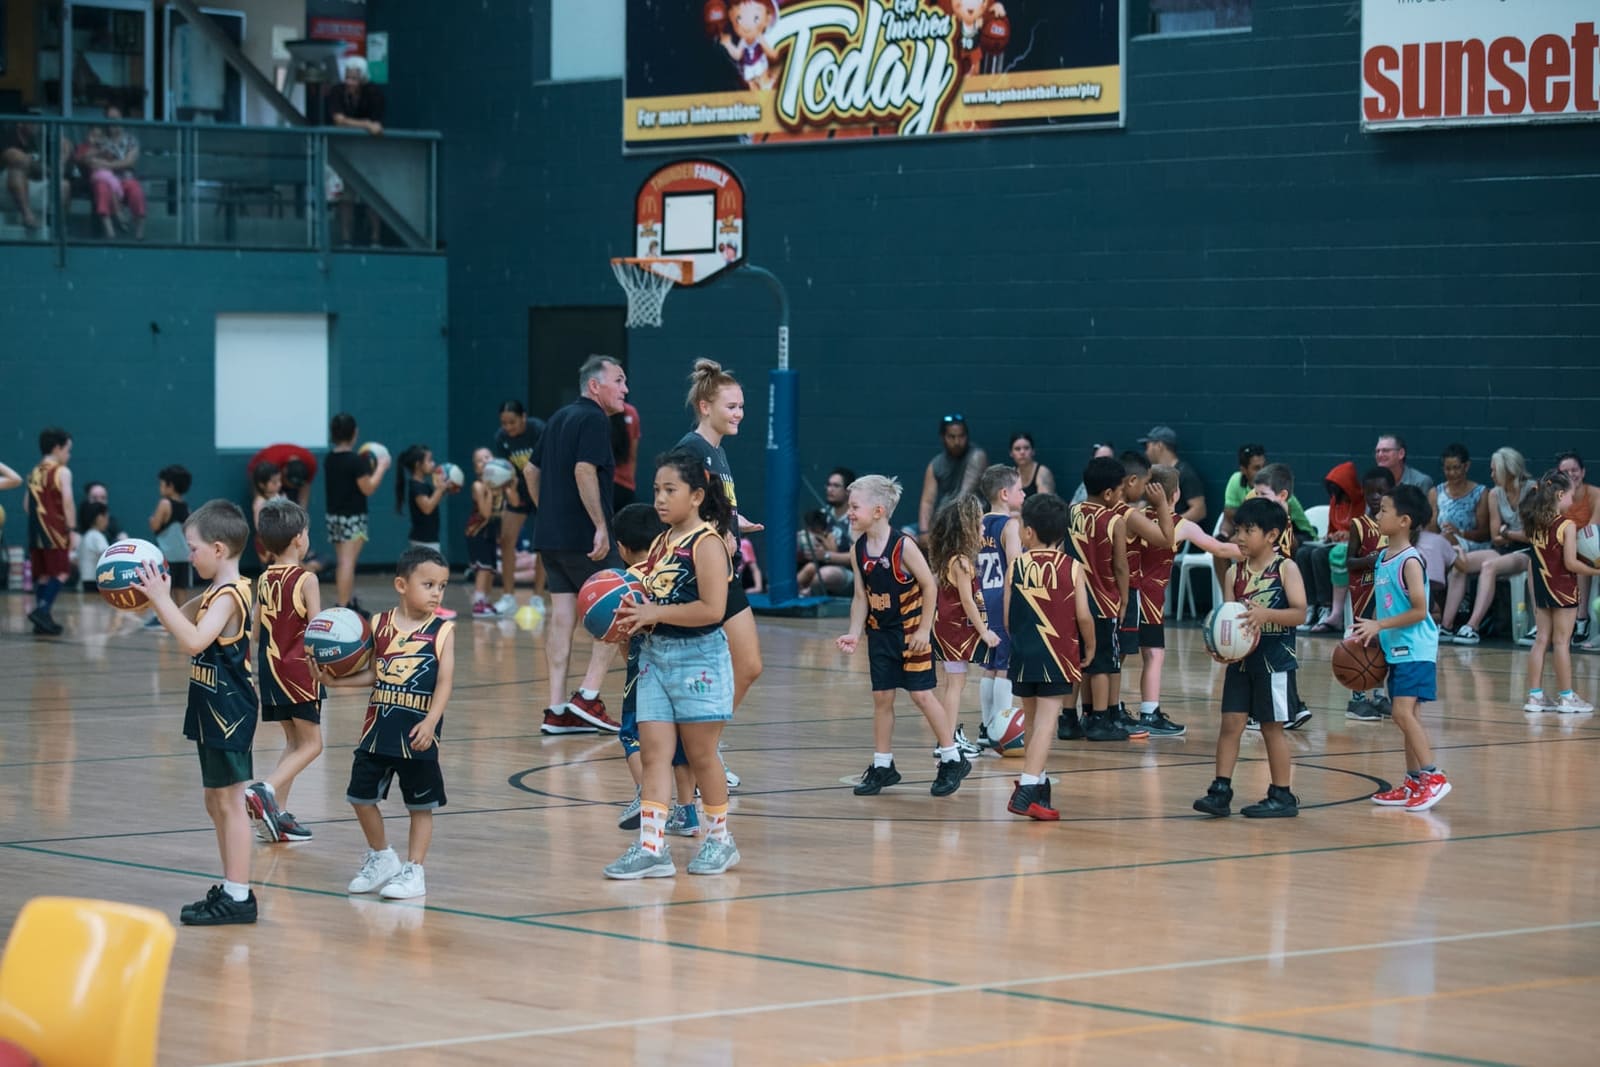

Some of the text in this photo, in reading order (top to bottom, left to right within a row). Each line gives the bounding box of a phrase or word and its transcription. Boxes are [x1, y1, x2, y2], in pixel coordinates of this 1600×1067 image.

[764, 0, 953, 136] Today
[638, 103, 760, 128] For more information:
[978, 552, 1004, 590] 23
